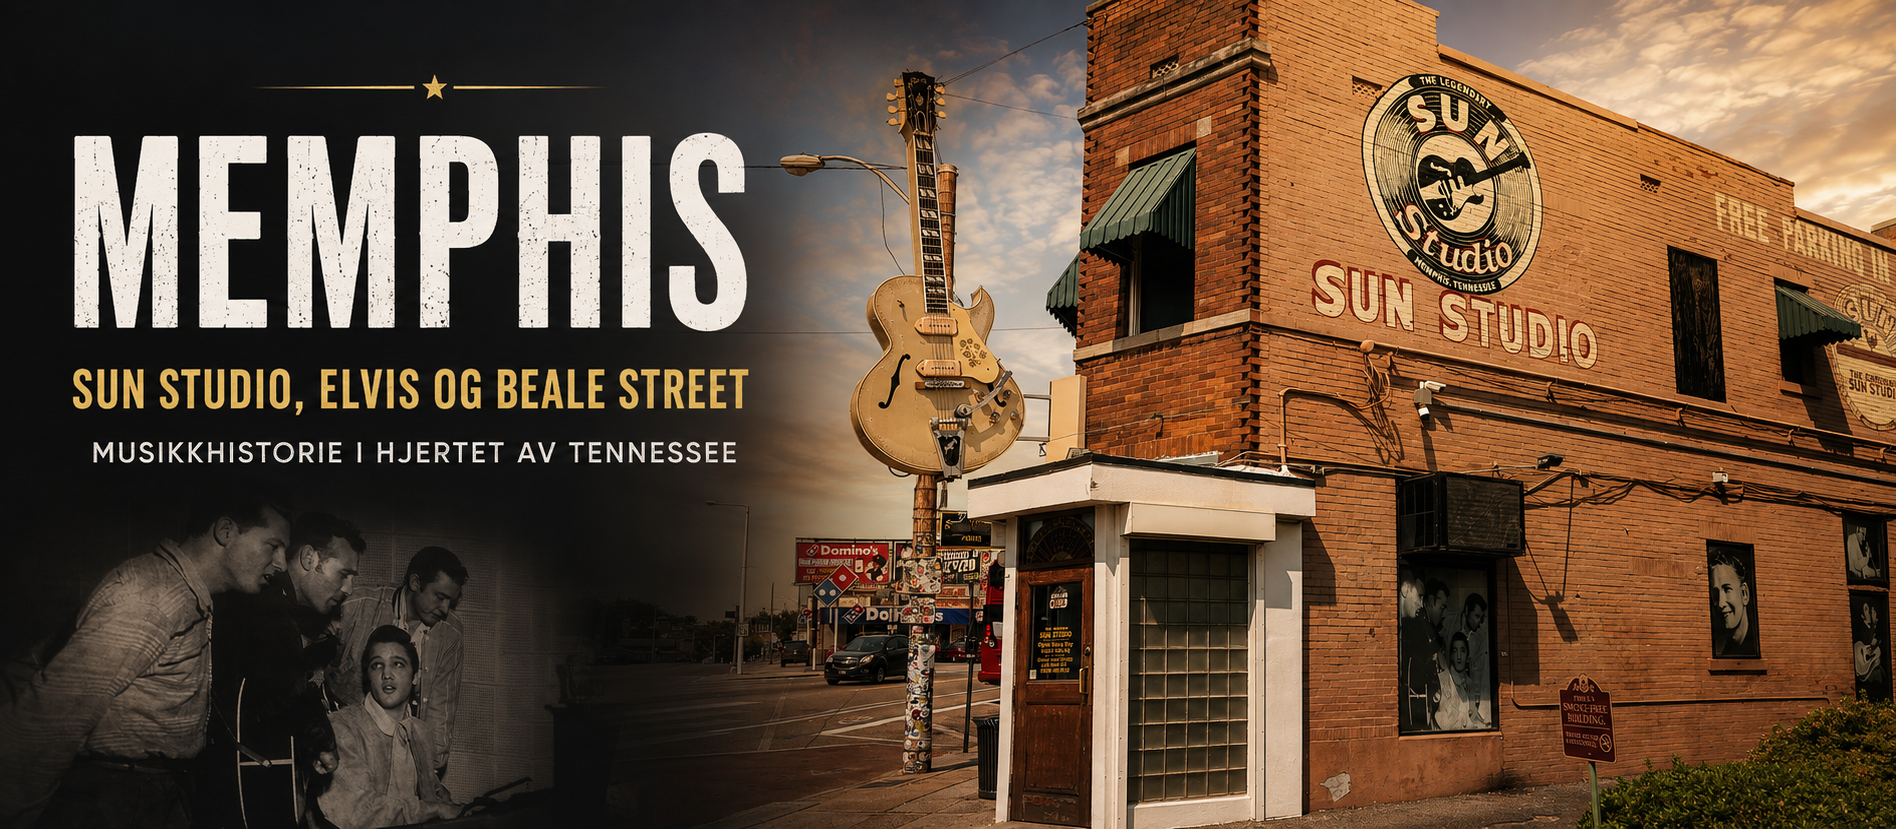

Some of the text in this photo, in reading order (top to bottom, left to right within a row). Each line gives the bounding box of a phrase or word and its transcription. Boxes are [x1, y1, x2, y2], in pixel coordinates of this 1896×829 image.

[1419, 75, 1492, 110] THE LEGENDARY
[1406, 93, 1511, 164] SUN
[1395, 203, 1513, 276] Studio
[1714, 191, 1770, 244] FREE
[1781, 216, 1866, 278] PARKING
[1311, 259, 1599, 370] SUN STUDIO
[1848, 378, 1868, 394] SUN
[820, 544, 879, 556] Domino's
